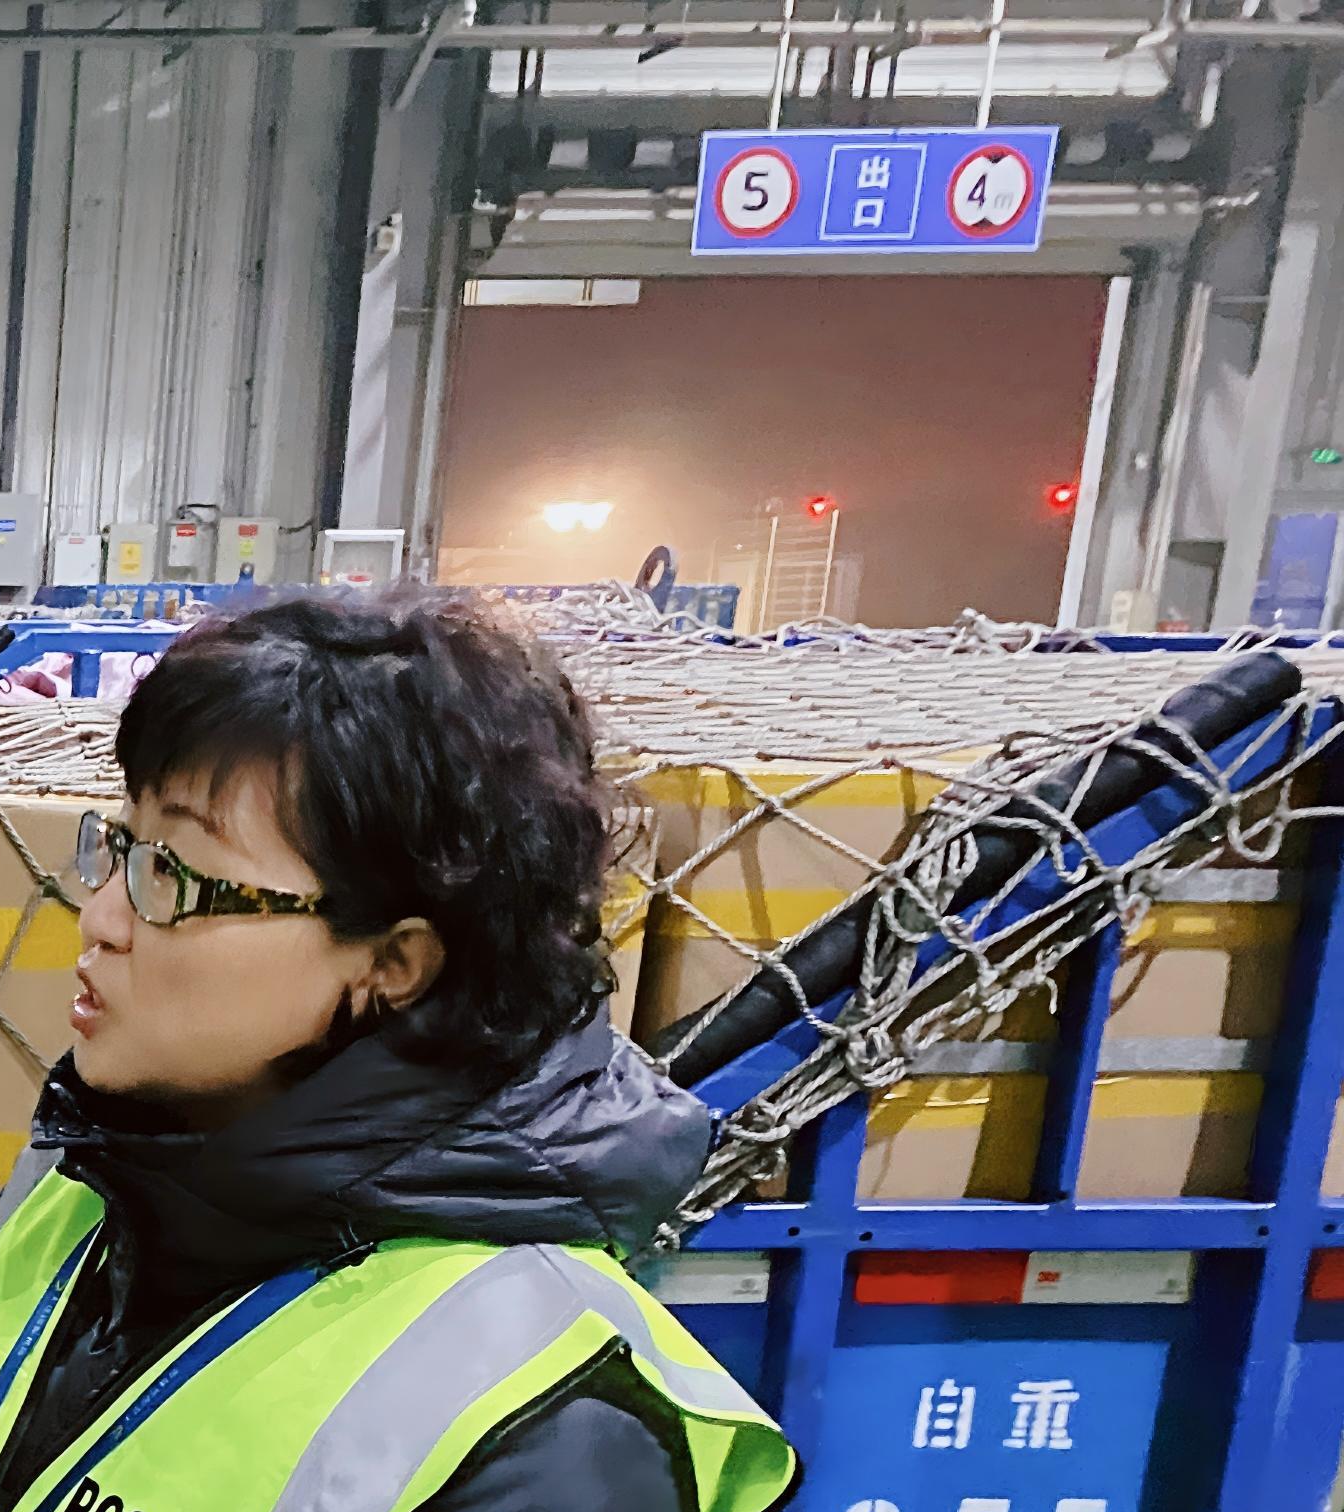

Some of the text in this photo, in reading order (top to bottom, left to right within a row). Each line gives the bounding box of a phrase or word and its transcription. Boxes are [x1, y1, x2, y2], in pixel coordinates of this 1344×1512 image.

[741, 171, 770, 211] 5
[853, 155, 891, 228] 出口
[912, 1378, 1080, 1449] 自重
